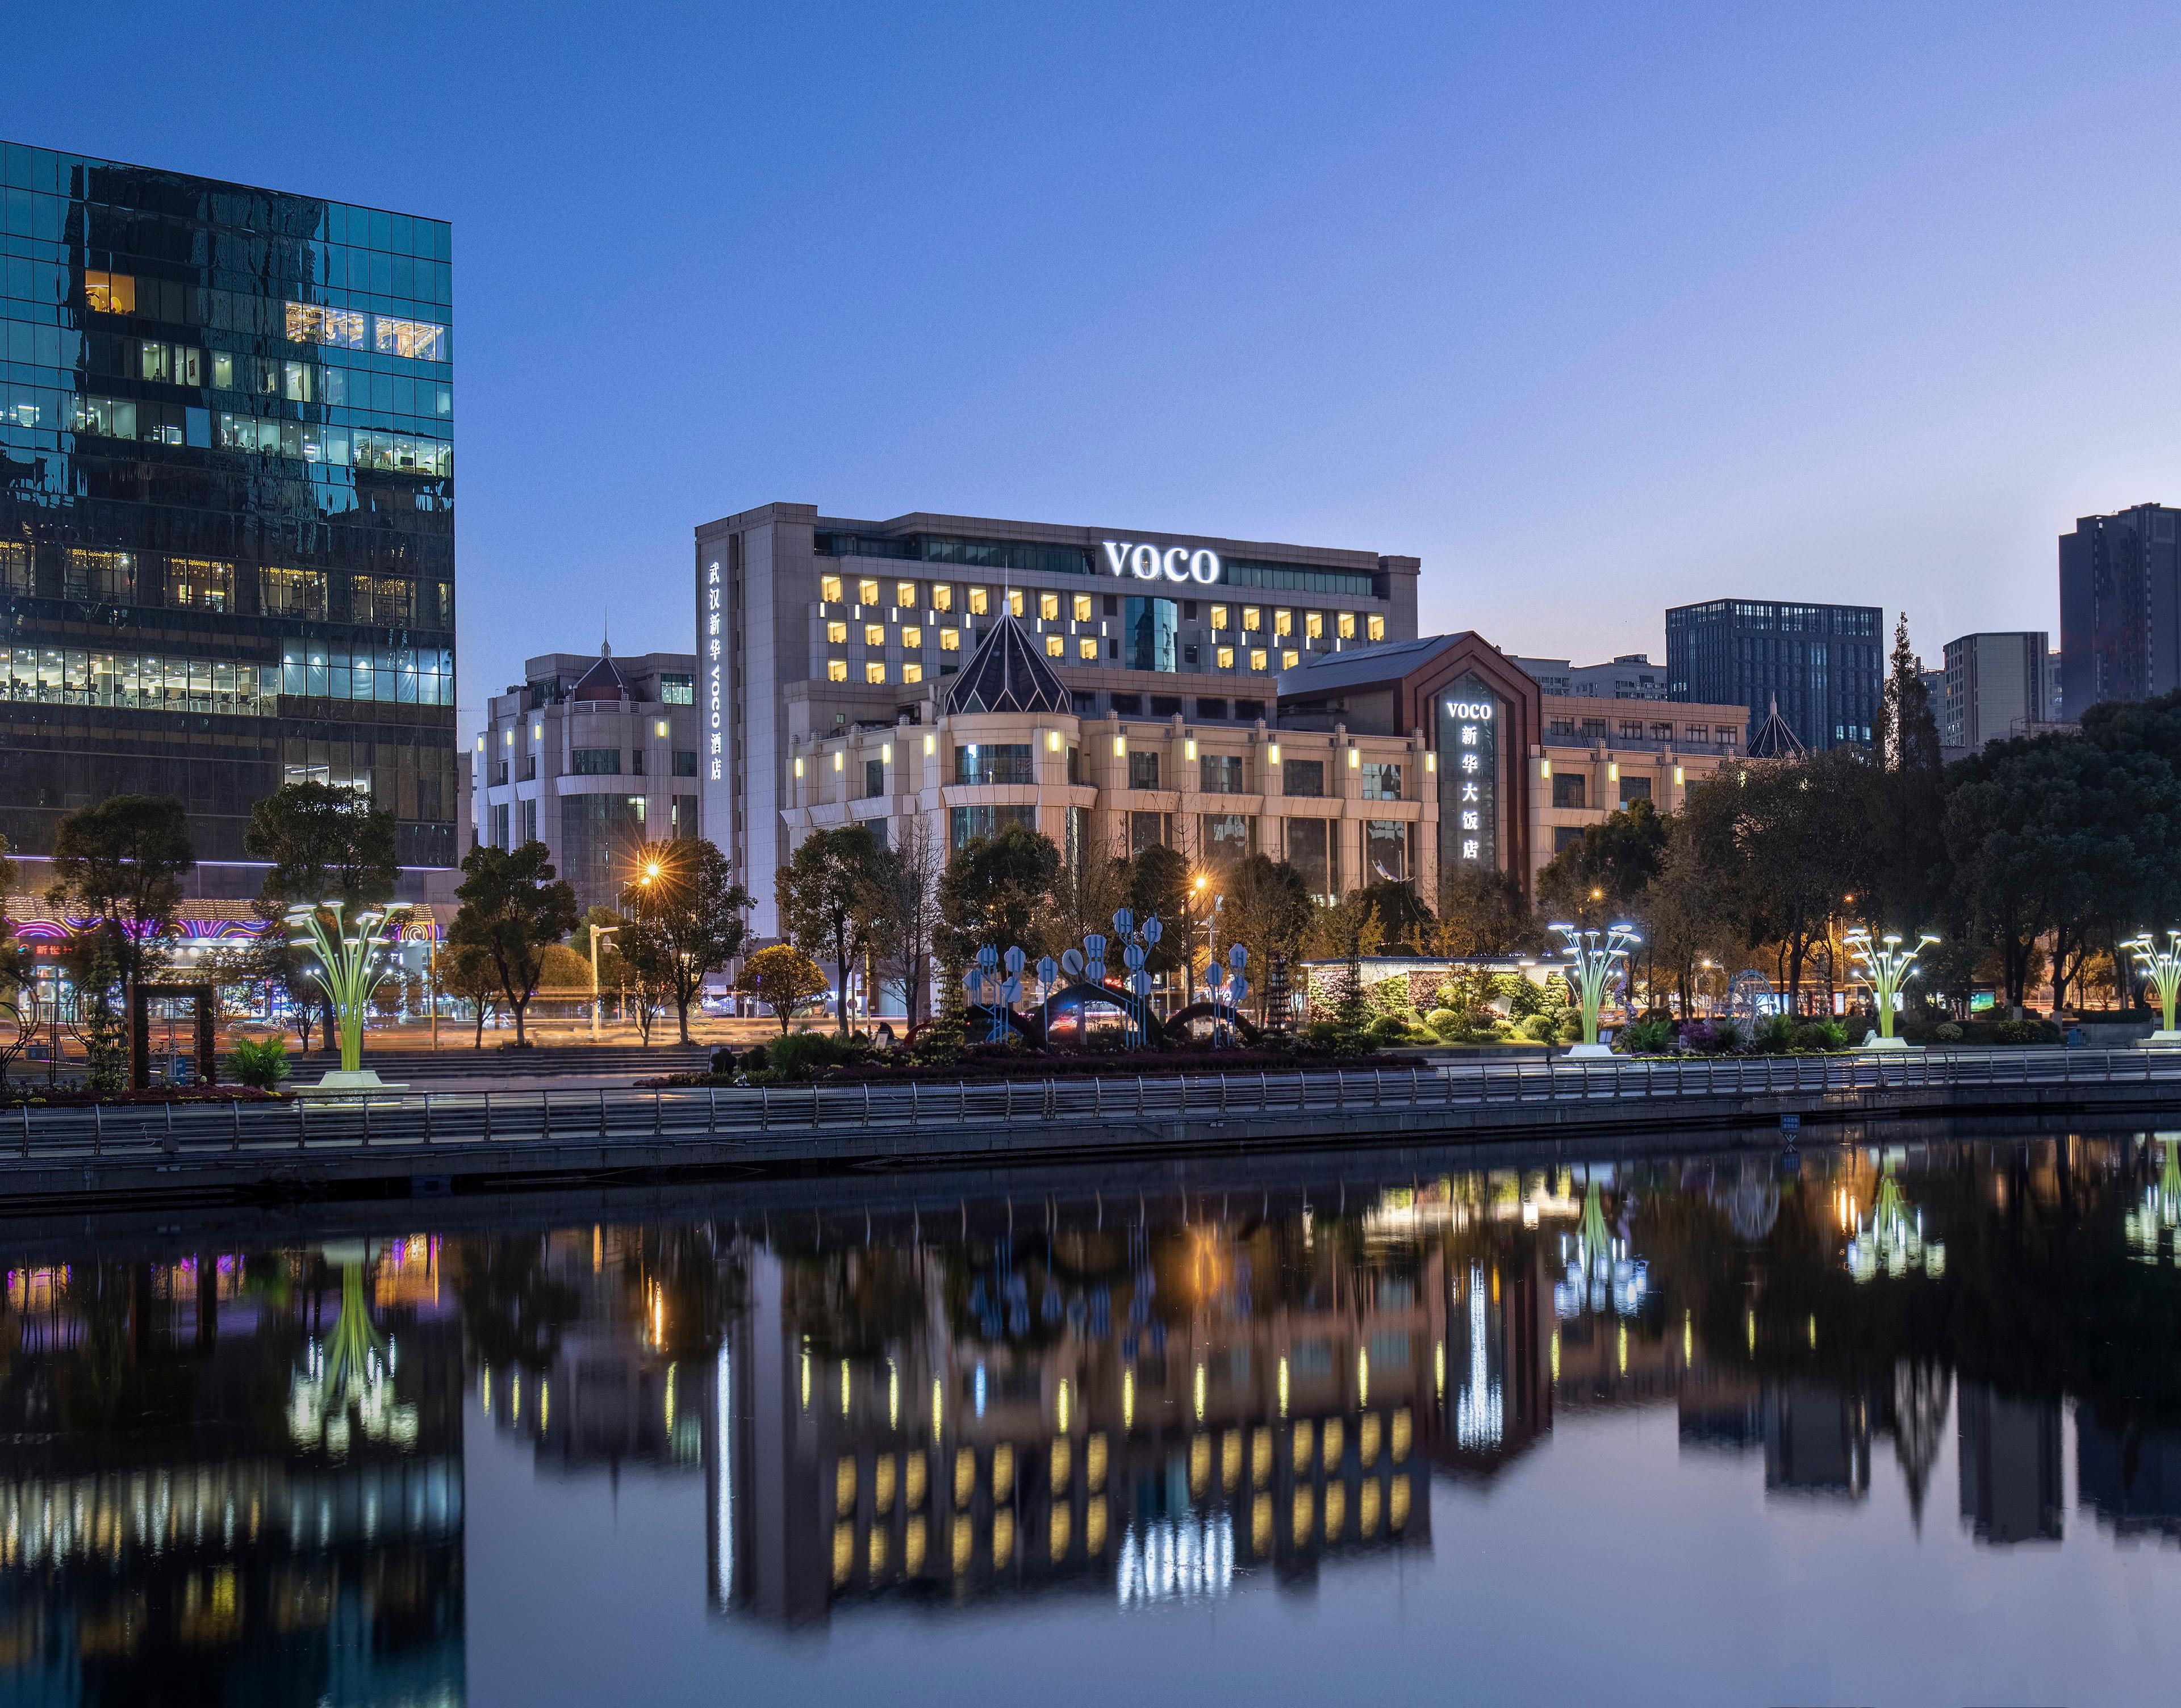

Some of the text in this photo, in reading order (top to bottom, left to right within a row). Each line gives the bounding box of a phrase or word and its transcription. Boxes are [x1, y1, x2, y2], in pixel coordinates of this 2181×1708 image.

[1102, 542, 1218, 584] VOCO
[1447, 702, 1491, 719] VOCO
[1462, 725, 1478, 859] 新华大饭店
